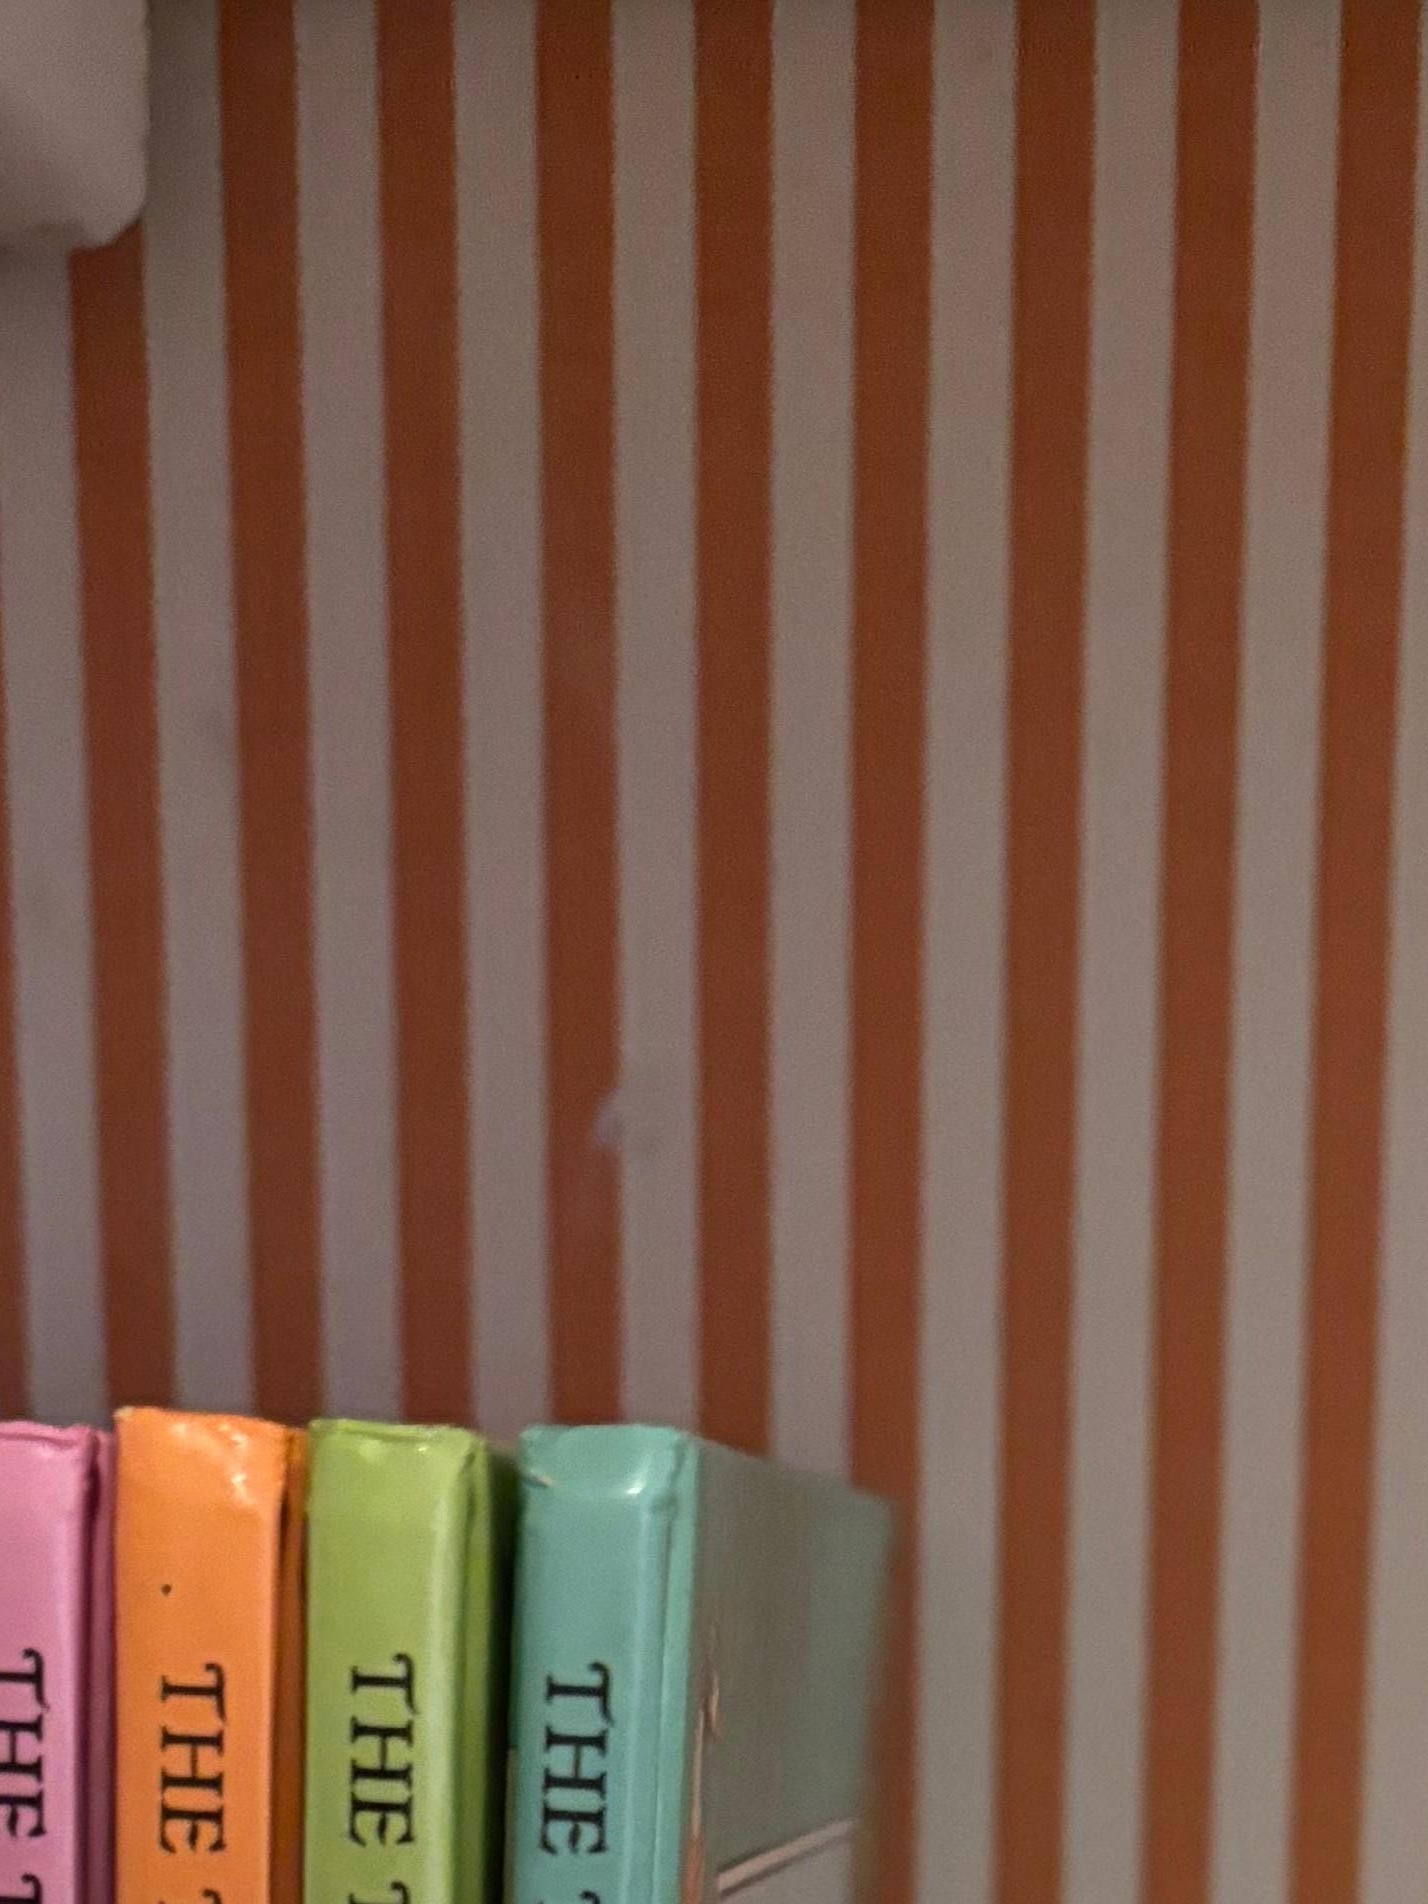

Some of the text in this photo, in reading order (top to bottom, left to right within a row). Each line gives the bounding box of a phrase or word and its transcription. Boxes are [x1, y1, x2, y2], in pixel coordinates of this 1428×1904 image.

[159, 1663, 226, 1853] THE
[349, 1653, 417, 1846] THE
[540, 1661, 614, 1855] THE
